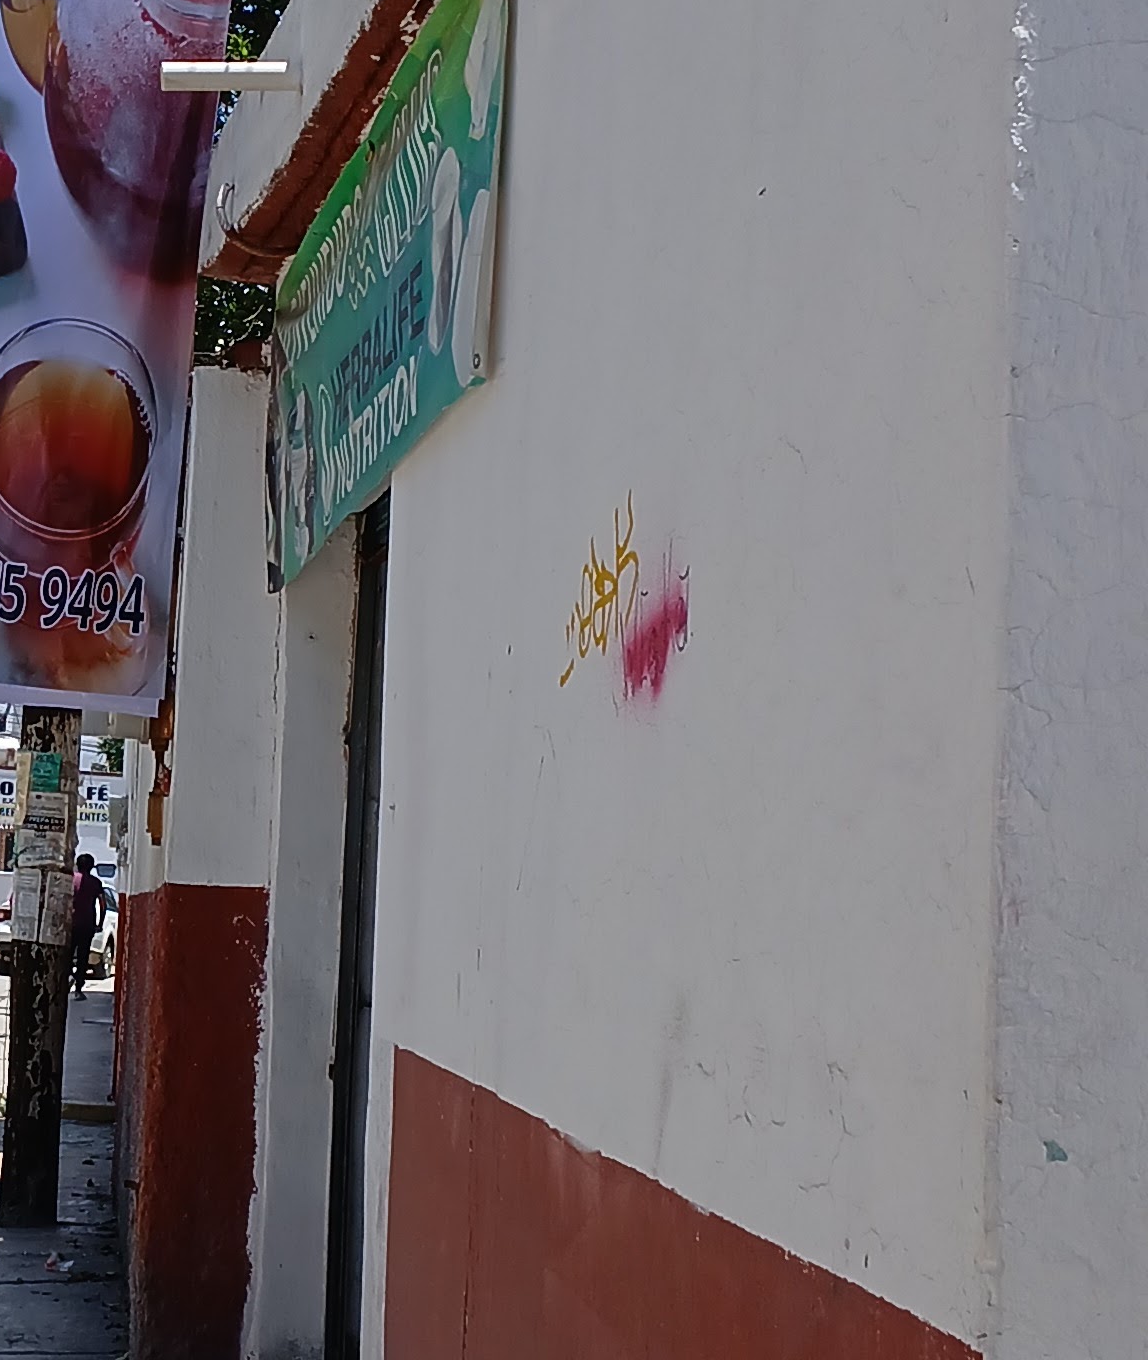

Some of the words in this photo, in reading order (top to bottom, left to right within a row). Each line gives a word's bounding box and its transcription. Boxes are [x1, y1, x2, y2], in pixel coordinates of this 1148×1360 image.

[330, 259, 427, 432] HERBALIFE
[333, 345, 424, 505] NUTRITION
[40, 567, 146, 635] 9494
